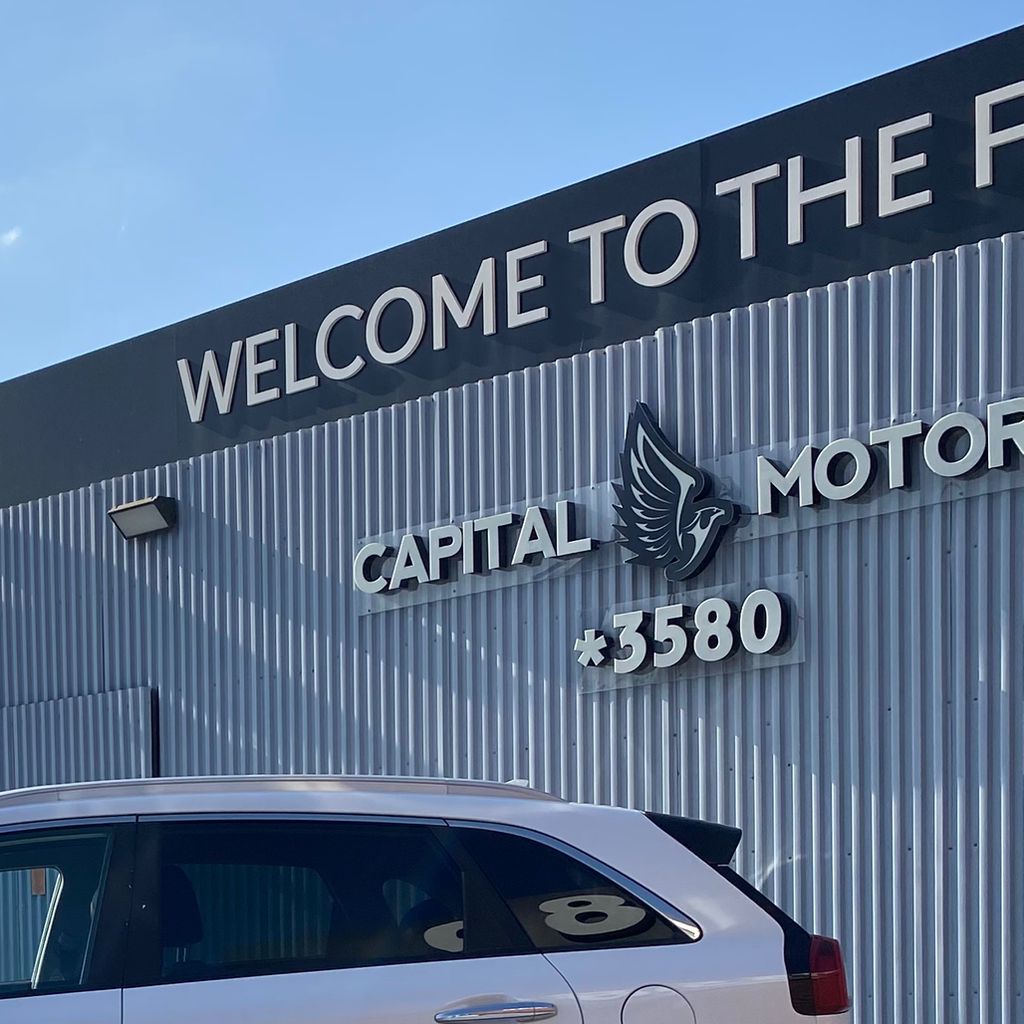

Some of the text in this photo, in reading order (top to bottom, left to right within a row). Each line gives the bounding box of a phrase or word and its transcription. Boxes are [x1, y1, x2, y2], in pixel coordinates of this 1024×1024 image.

[177, 240, 549, 424] WELCOME
[568, 199, 699, 304] TO
[715, 112, 933, 260] THE
[353, 397, 1024, 594] CAPITAL MOTOR
